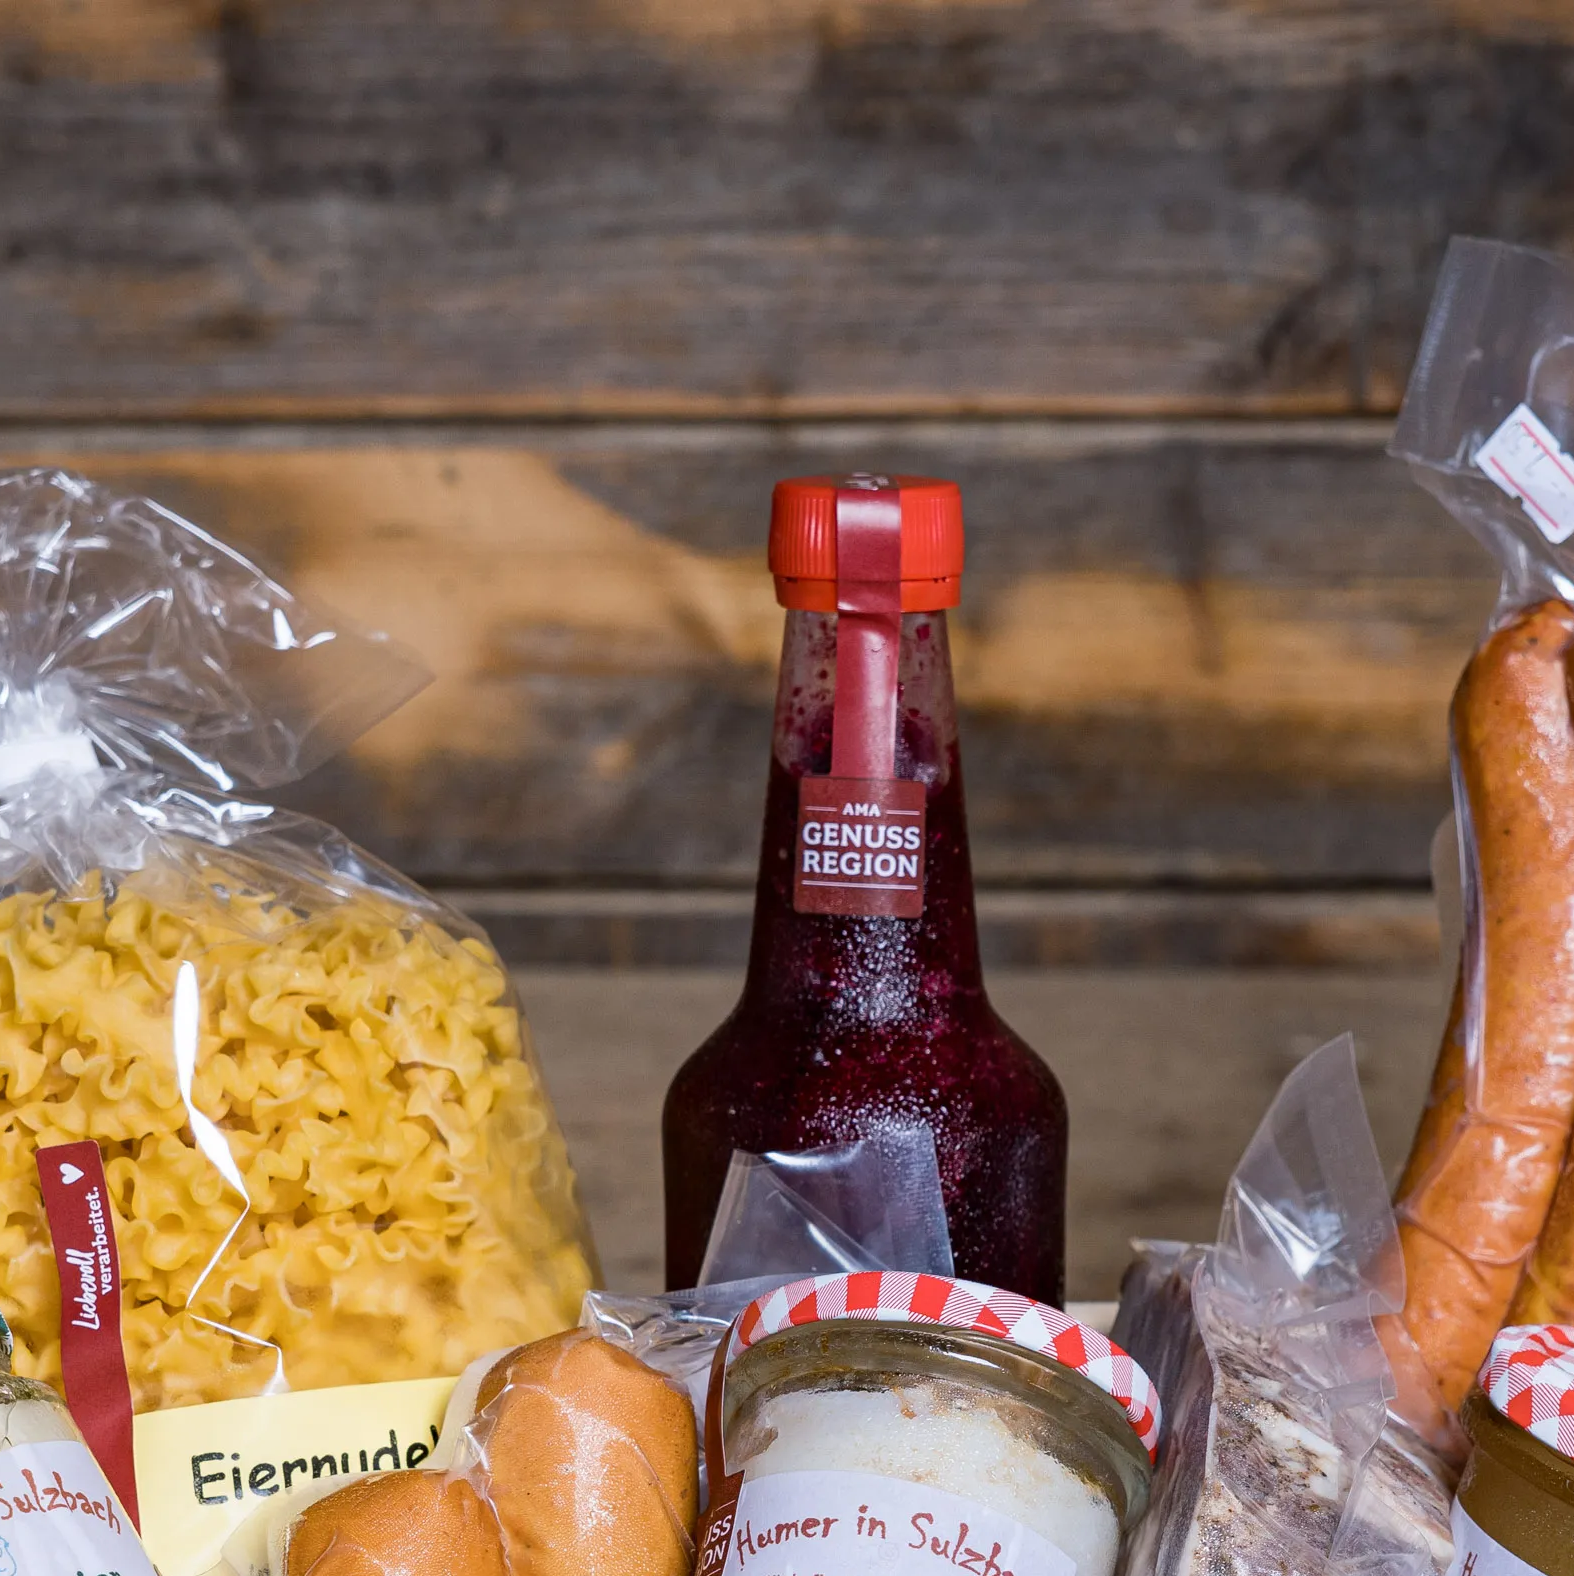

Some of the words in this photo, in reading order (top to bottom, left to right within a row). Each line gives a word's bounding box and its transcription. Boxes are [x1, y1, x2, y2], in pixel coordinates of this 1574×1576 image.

[842, 802, 881, 817] AMA
[802, 821, 921, 850] GENUSS
[802, 851, 919, 879] REGION
[85, 1187, 112, 1294] verarbeitet.
[66, 1248, 99, 1329] Liebevoll
[736, 1518, 838, 1566] Humer
[856, 1504, 888, 1538] in
